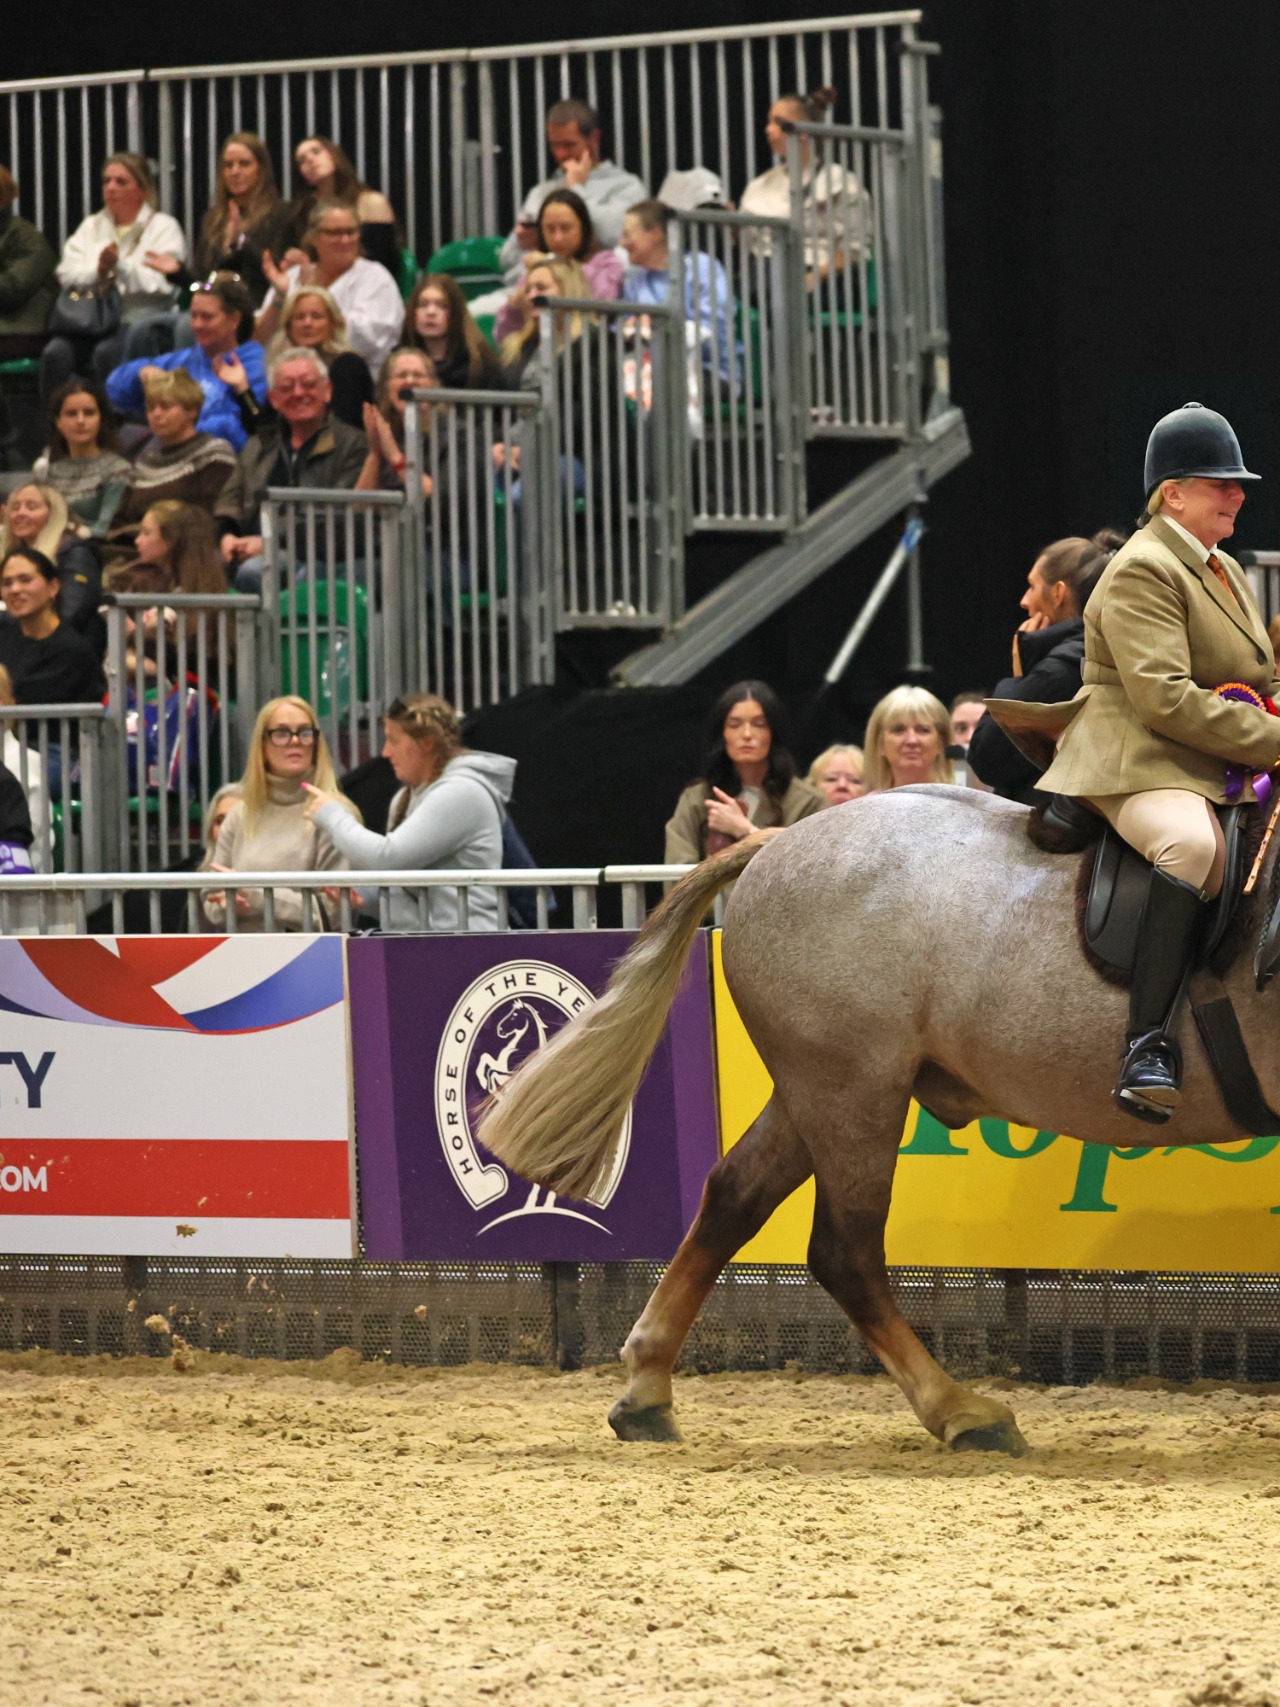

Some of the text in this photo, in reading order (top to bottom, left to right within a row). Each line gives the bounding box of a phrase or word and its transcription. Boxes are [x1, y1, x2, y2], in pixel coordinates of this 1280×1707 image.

[446, 973, 586, 1175] HORSE OF THE YE
[0, 1165, 48, 1192] OM
